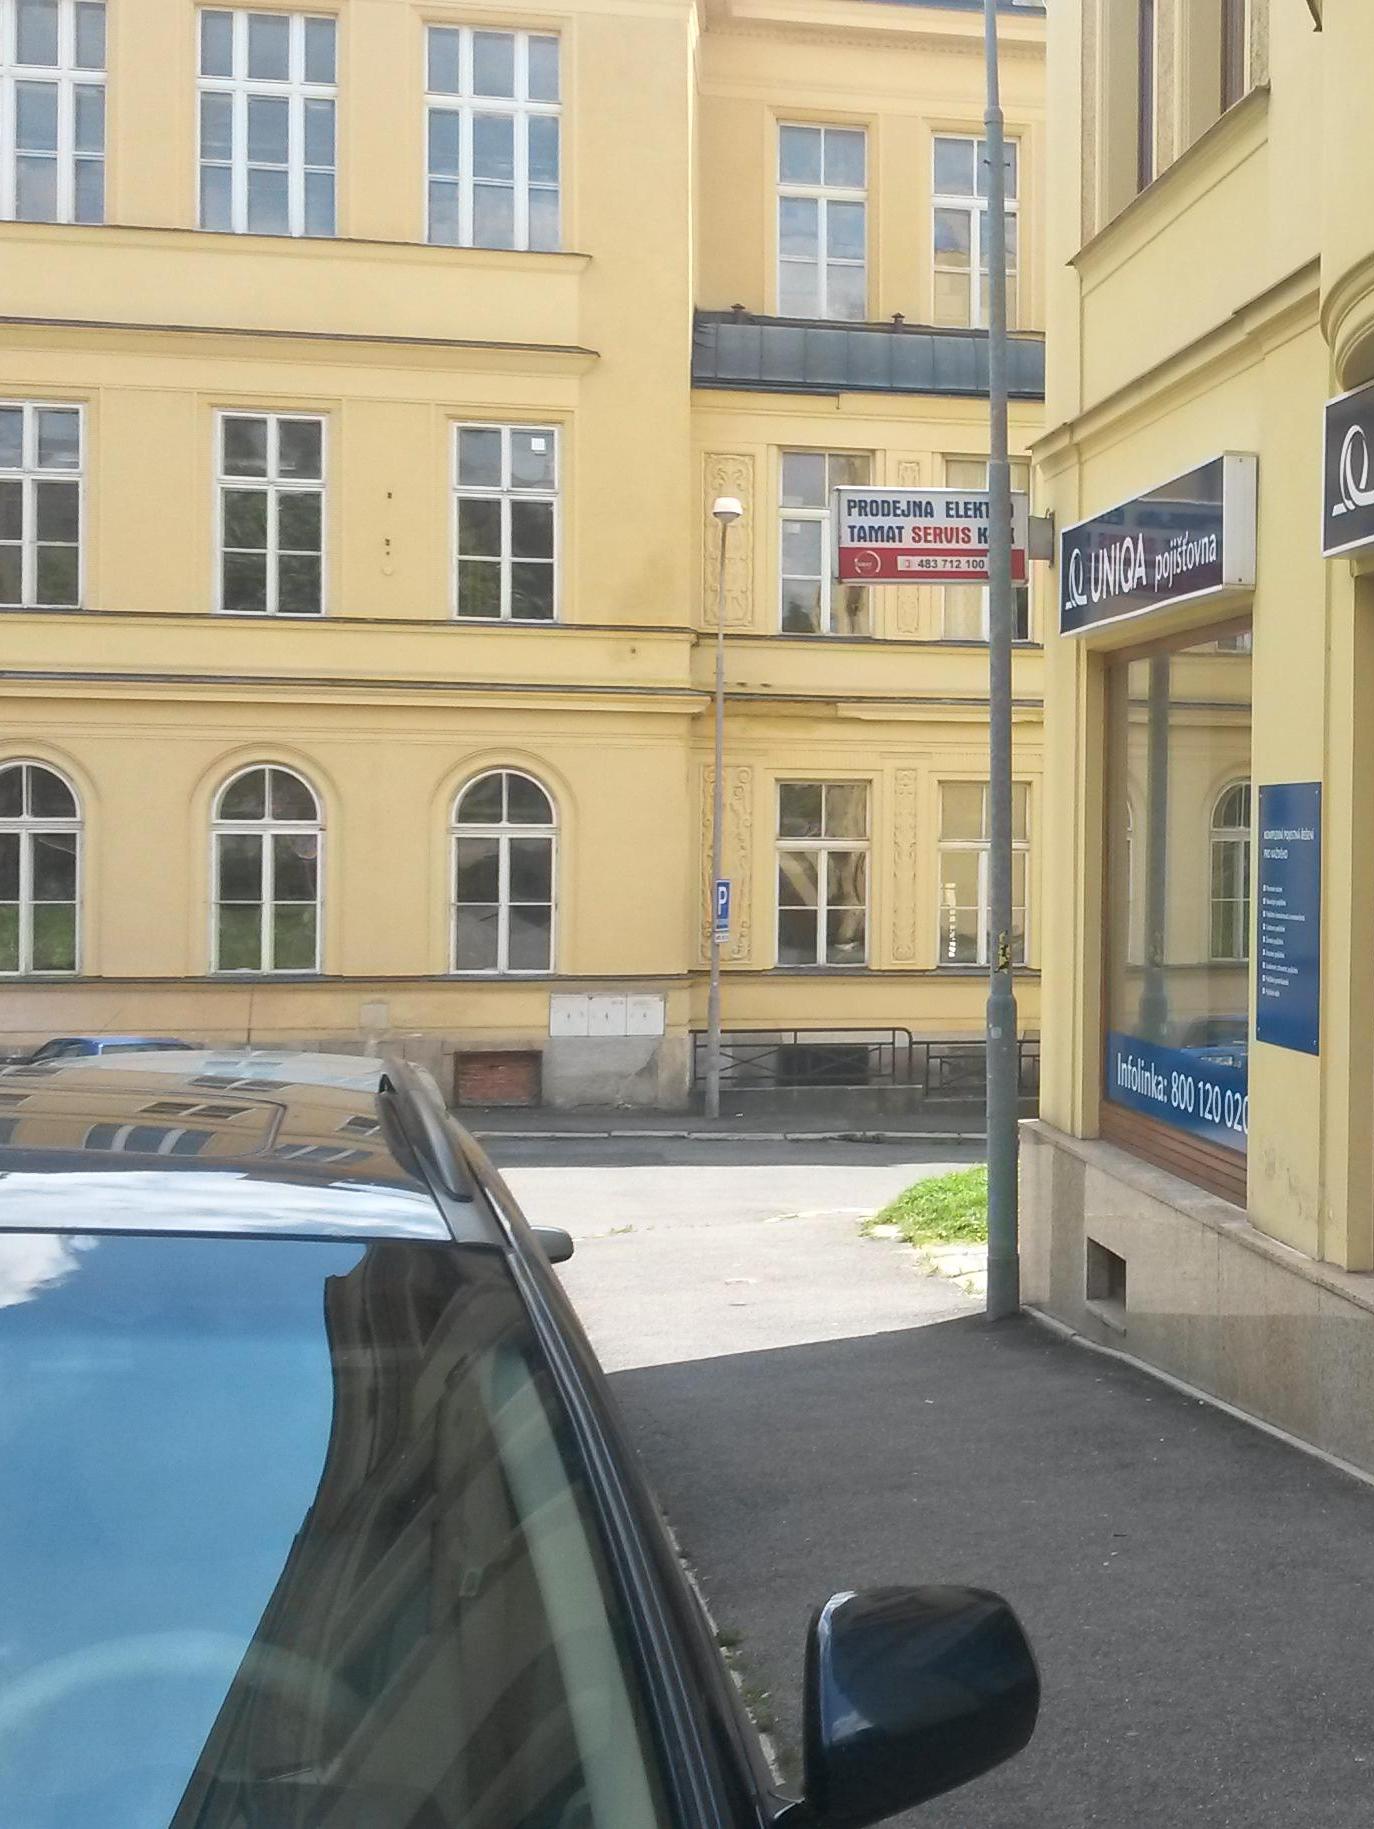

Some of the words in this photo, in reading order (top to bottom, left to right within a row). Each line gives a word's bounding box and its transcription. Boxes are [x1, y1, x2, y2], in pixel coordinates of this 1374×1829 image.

[847, 499, 934, 518] PRODEJNA
[848, 525, 905, 543] TAMAT
[911, 526, 972, 544] SERVIS
[918, 559, 938, 569] 483
[942, 559, 961, 569] 712
[966, 559, 985, 569] 100
[1090, 533, 1147, 603] UNIQA
[1154, 530, 1217, 592] pojišťovna
[718, 886, 728, 916] P
[1117, 1053, 1168, 1103] Infolinka:
[1171, 1071, 1195, 1113] 800
[1198, 1081, 1221, 1123] 120
